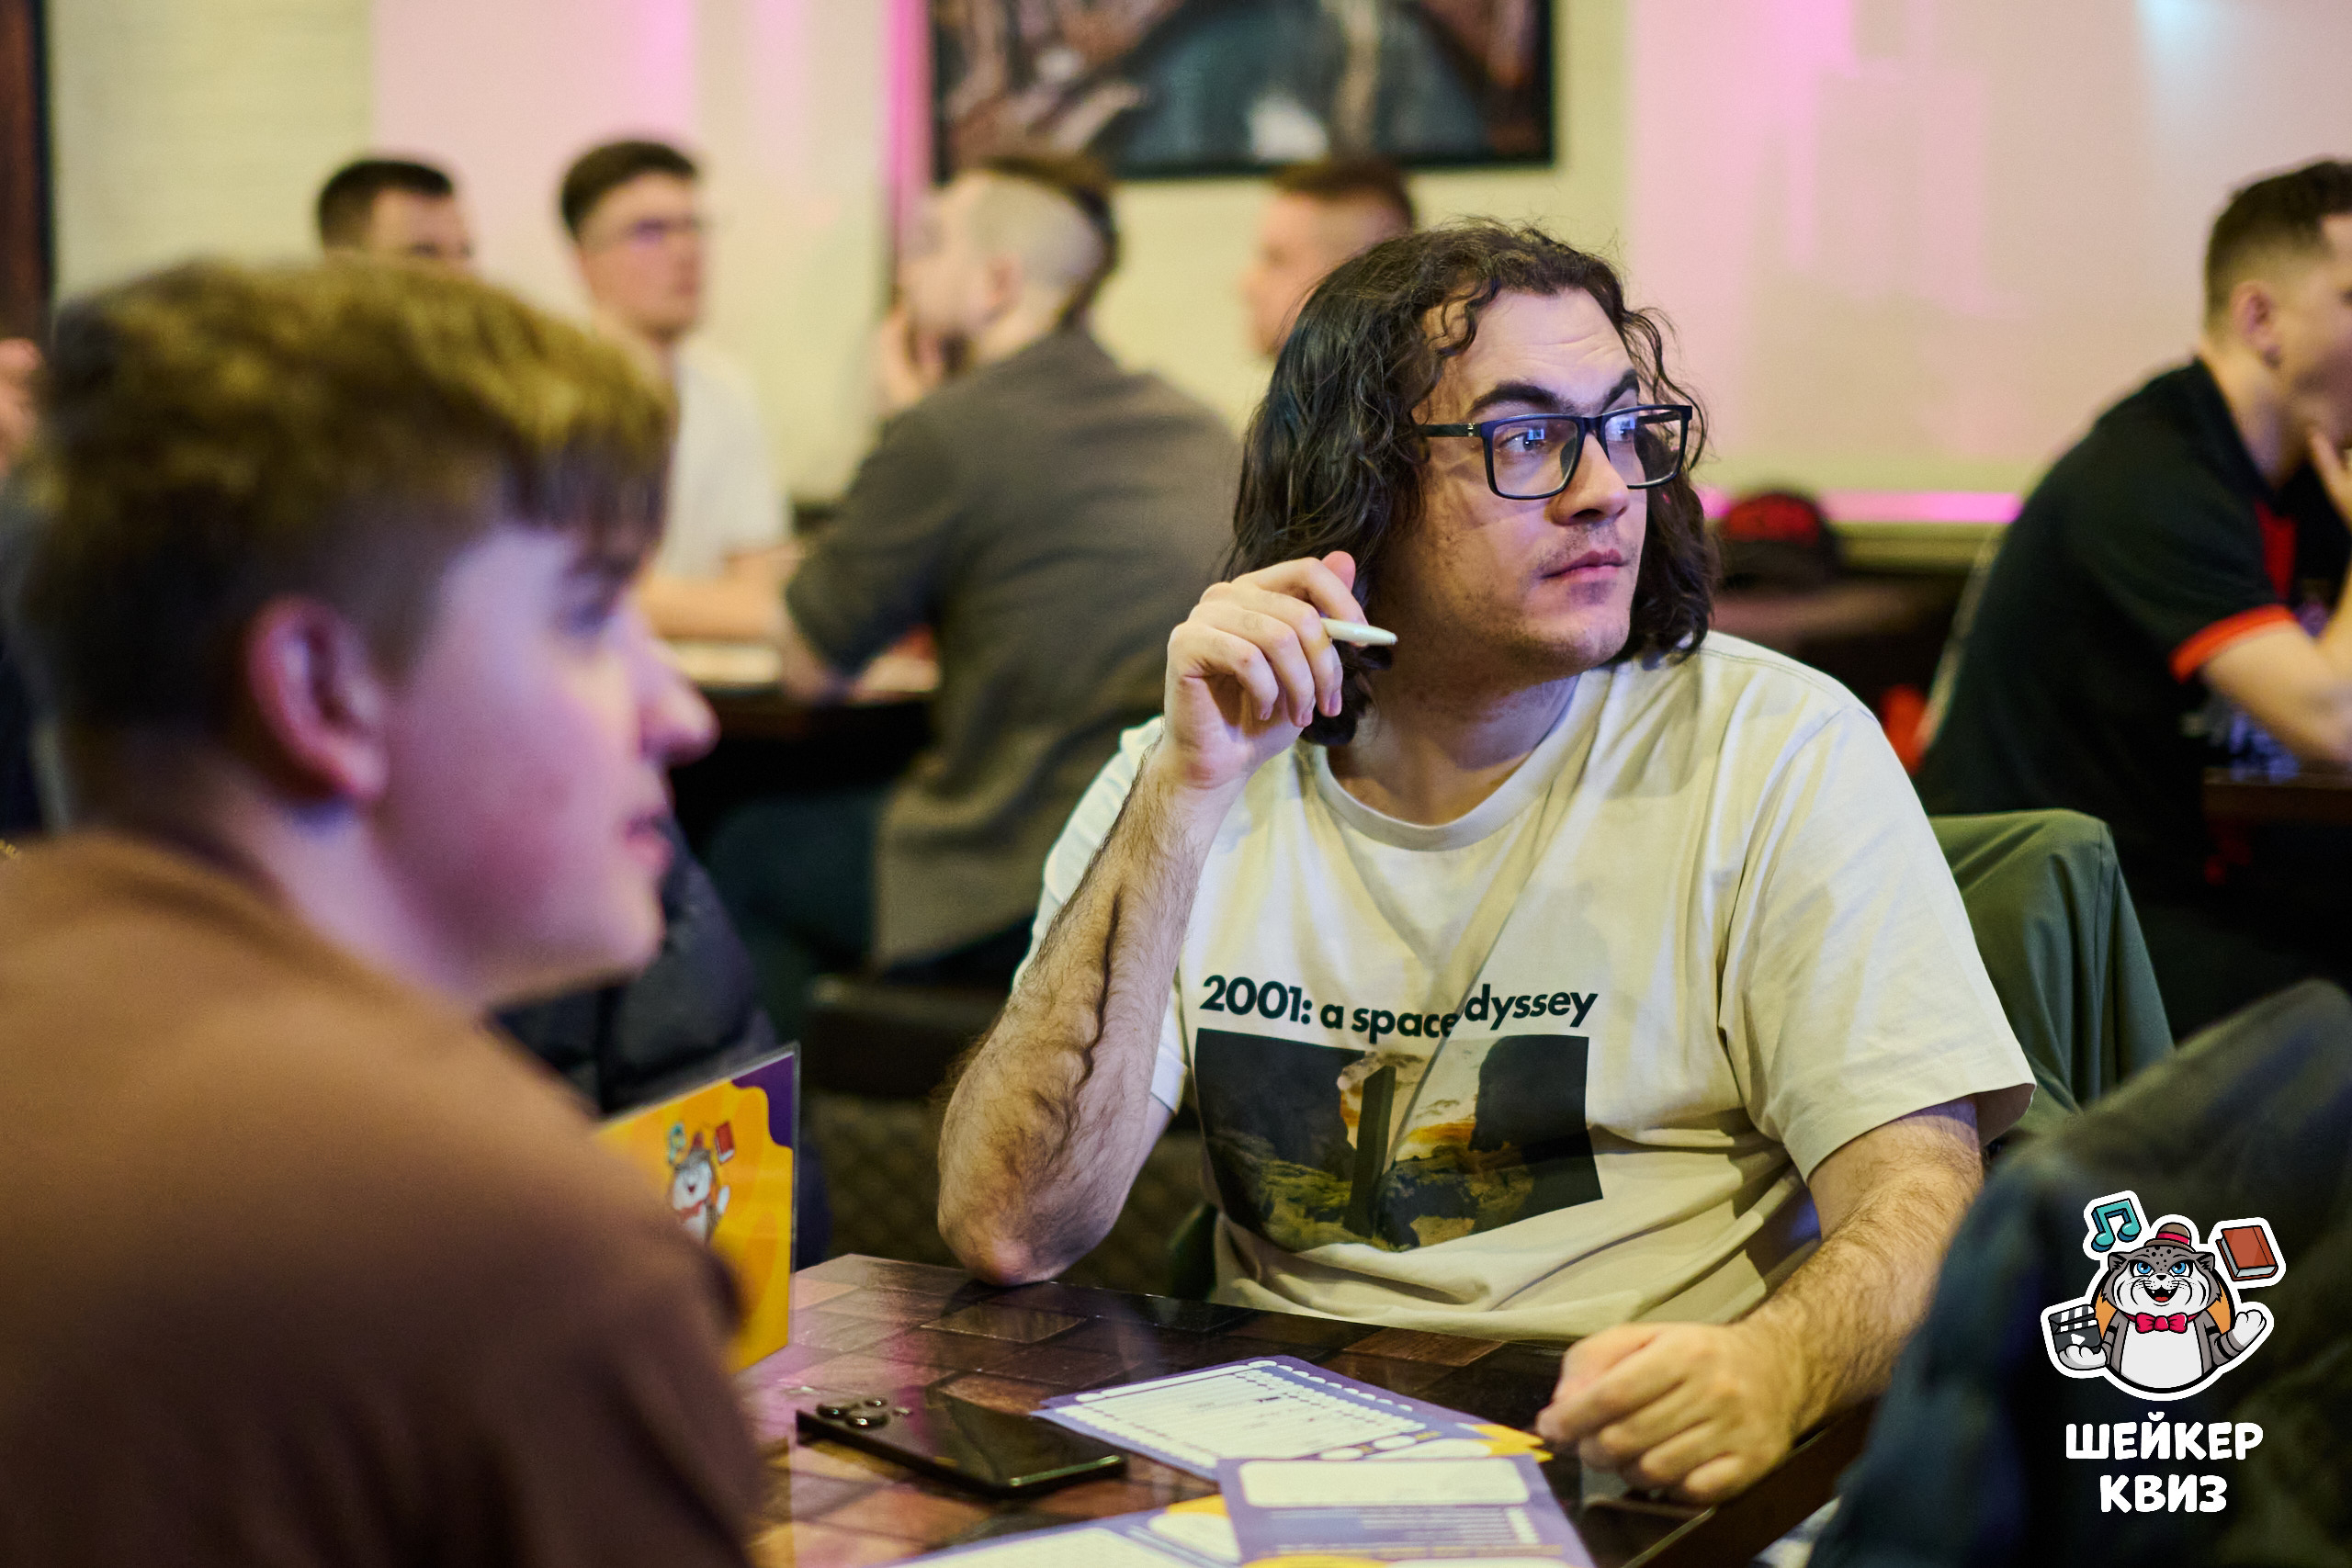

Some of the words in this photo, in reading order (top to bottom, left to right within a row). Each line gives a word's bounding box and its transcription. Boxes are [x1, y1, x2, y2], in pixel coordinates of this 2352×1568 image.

[1199, 975, 1312, 1024] 2001:
[1320, 1004, 1344, 1029] a
[1351, 1008, 1459, 1044] space
[1463, 984, 1599, 1031] dyssey
